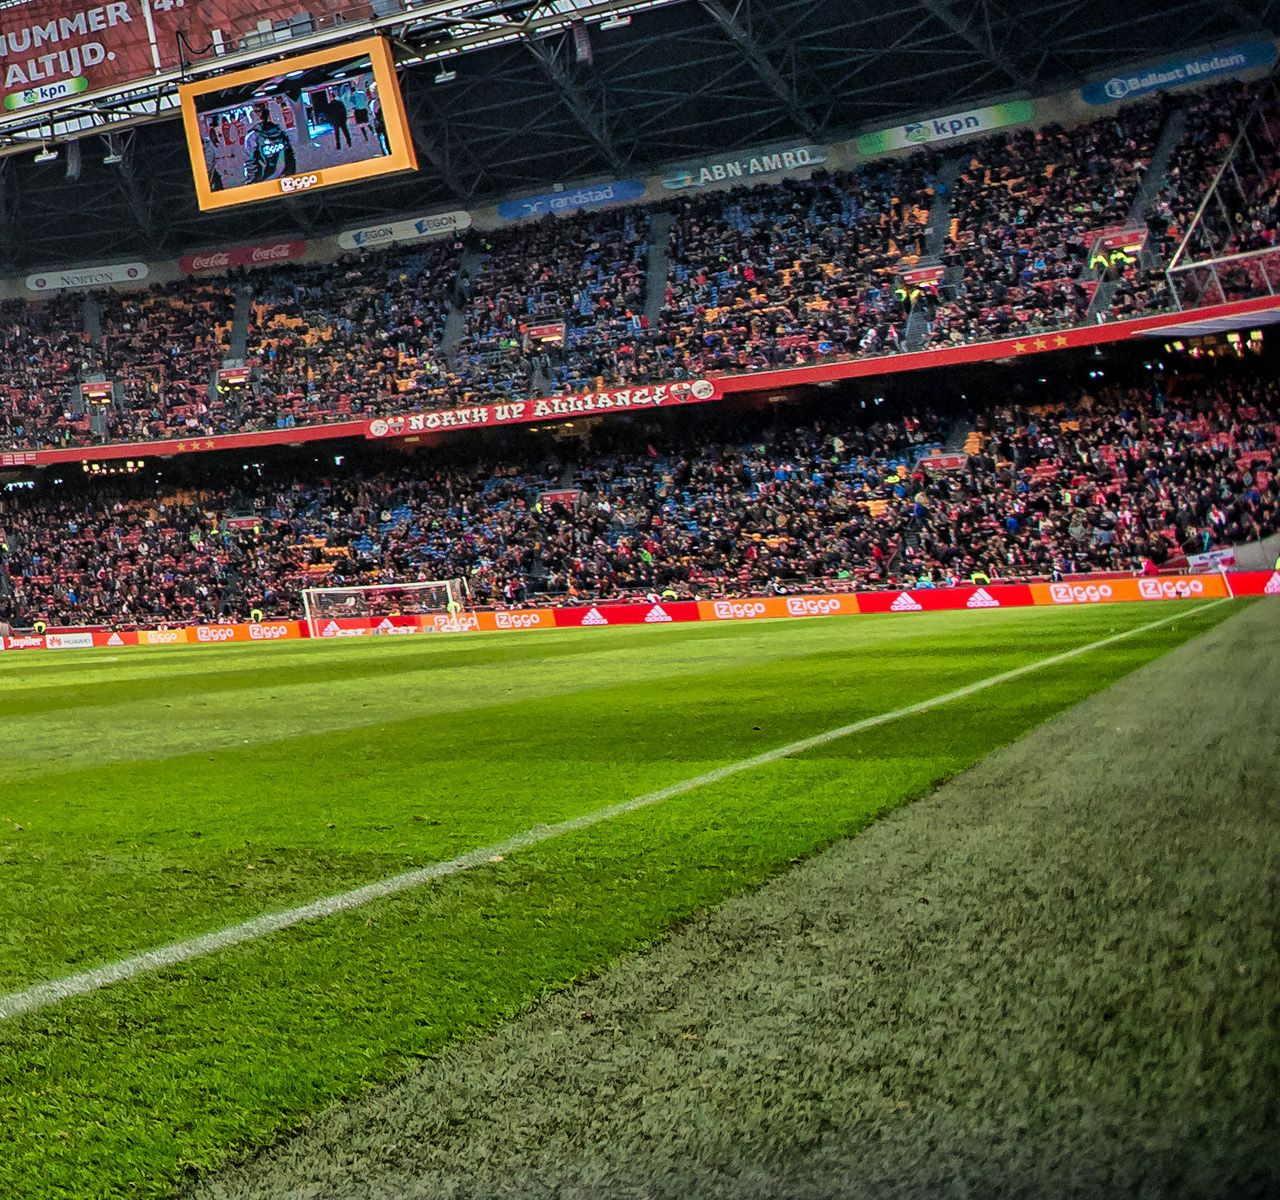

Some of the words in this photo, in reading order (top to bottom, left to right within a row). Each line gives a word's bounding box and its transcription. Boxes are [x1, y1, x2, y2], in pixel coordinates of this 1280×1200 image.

[3, 41, 117, 90] ALTIJD.
[1127, 68, 1184, 91] Ballast
[1186, 53, 1244, 77] Nedam
[40, 83, 66, 99] kpn
[934, 114, 980, 138] kpn
[280, 174, 318, 192] Ziggo
[550, 185, 614, 210] randstad
[60, 272, 113, 287] NORTON
[407, 407, 488, 432] NORTH
[494, 402, 525, 421] UP
[533, 385, 670, 418] ALLIANCE
[1049, 583, 1113, 604] Ziggo
[1138, 578, 1203, 600] Ziggo
[713, 600, 766, 620] Ziggo
[786, 596, 841, 615] Ziggo
[197, 626, 234, 642] Ziggo
[249, 623, 287, 640] Ziggo
[495, 612, 540, 629] Ziggo
[7, 635, 44, 649] Jupiler
